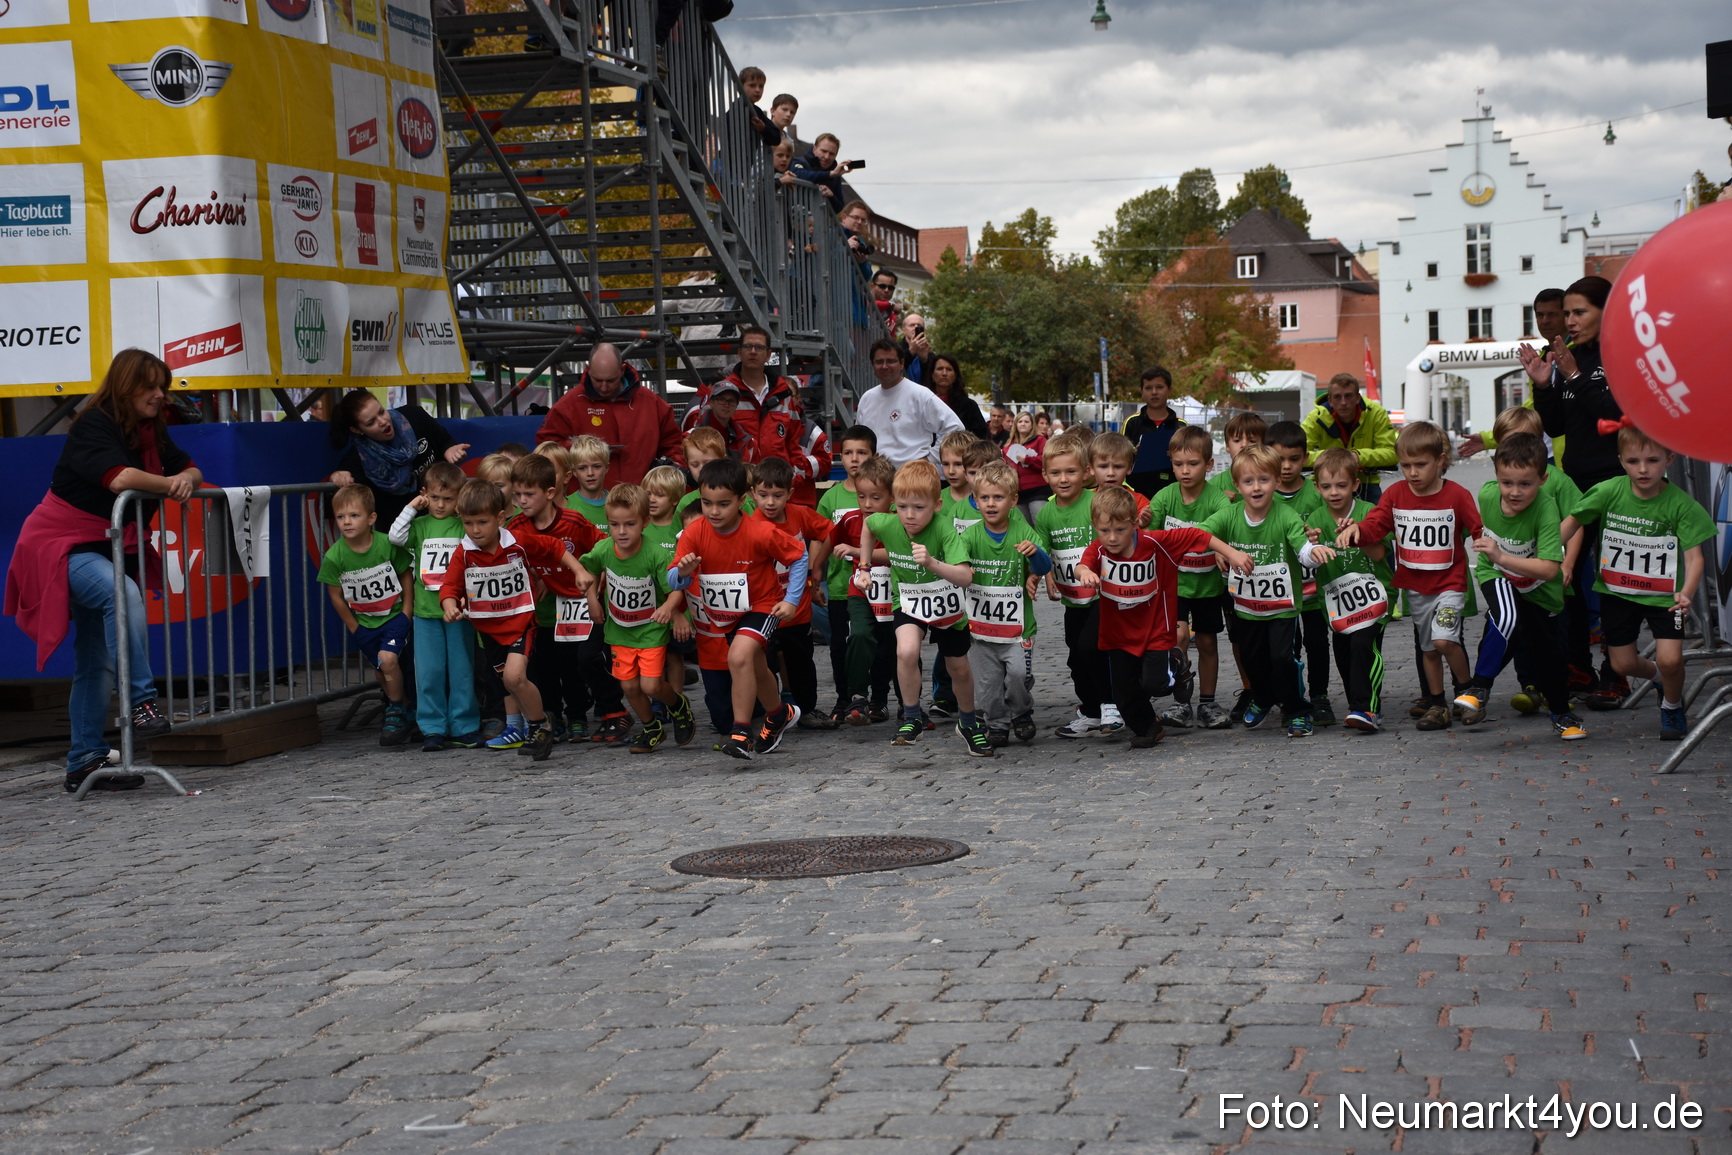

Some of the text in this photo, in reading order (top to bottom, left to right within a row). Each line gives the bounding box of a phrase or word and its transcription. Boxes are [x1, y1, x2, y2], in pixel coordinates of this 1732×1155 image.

[155, 69, 198, 85] MINI
[401, 109, 433, 144] Hervis
[356, 129, 370, 145] DEHN
[281, 184, 315, 199] GERHART
[5, 204, 63, 221] Tagblatt
[130, 186, 247, 234] Charivari
[0, 224, 72, 238] Hier lebe ich.
[357, 228, 376, 250] Braun
[299, 236, 315, 252] KIA
[407, 237, 433, 250] Neumarkter
[402, 250, 438, 269] Lammsbräu
[296, 289, 323, 328] RUND
[352, 319, 384, 342] swn
[404, 322, 453, 342] NATHUS
[186, 337, 226, 358] DEHN
[297, 330, 328, 361] SCHAU
[1628, 274, 1691, 414] RÖDL
[1439, 348, 1525, 363] BMW Laufs
[1636, 357, 1680, 419] energie
[1394, 514, 1411, 522] PARTL
[1607, 511, 1654, 527] Neumarkter
[1398, 523, 1450, 547] 7400
[1604, 534, 1665, 550] PARTL Neumarkt
[426, 551, 450, 571] 74
[889, 551, 916, 562] Neumar
[1182, 558, 1206, 566] atrick
[1609, 546, 1668, 575] 7111
[357, 570, 384, 583] Neumarkt
[466, 567, 519, 579] PARTL Neumarkt
[1107, 560, 1155, 584] 7000
[347, 575, 396, 602] 7434
[473, 572, 525, 599] 7058
[620, 582, 648, 590] Neumarkt
[921, 585, 951, 594] Neumarkt
[1118, 587, 1144, 596] Lukas
[1233, 576, 1286, 599] 7126
[1621, 576, 1652, 589] Simon
[609, 582, 652, 610] 7082
[1332, 581, 1380, 617] 7096
[490, 602, 512, 611] Vitus
[615, 610, 638, 621] Niklas
[908, 593, 960, 619] 7039
[971, 596, 1018, 622] 7442
